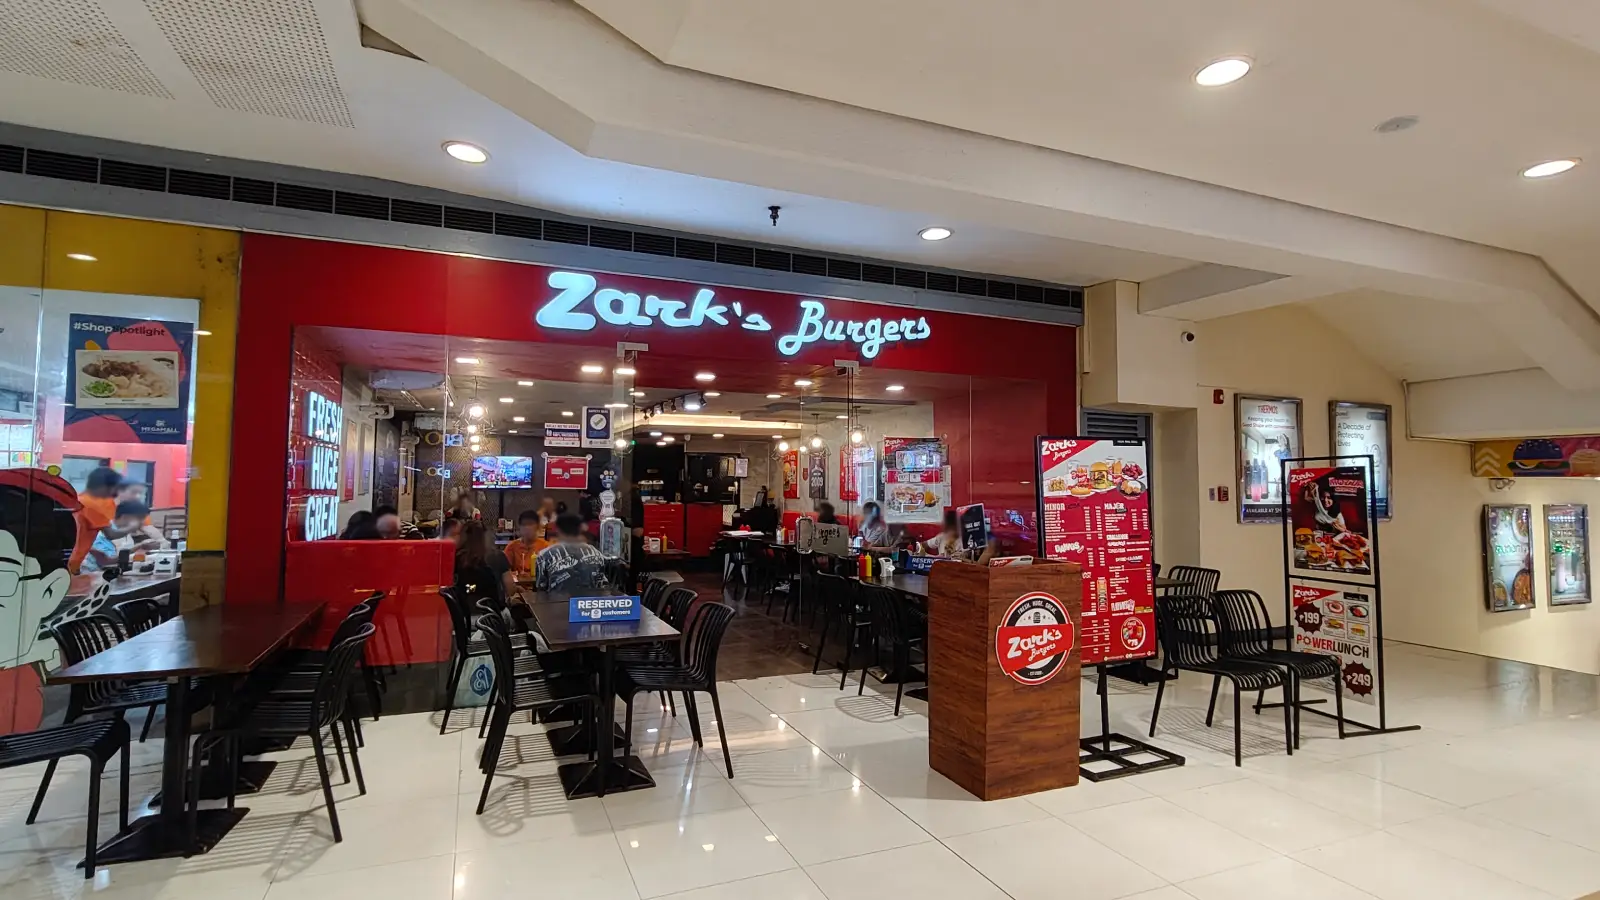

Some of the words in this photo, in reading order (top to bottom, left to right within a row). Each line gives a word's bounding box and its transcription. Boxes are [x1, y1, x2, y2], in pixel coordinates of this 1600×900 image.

[535, 271, 772, 332] Zark's
[777, 300, 932, 360] Burgers
[308, 391, 343, 445] FRESH
[1343, 422, 1364, 430] Decade
[1337, 431, 1365, 440] Protecting
[1338, 439, 1351, 447] Lives
[1042, 439, 1077, 456] Zark's
[311, 446, 340, 490] HUGE
[1045, 503, 1066, 511] MINOR
[305, 495, 340, 542] GREAT
[577, 599, 633, 609] RESERVED
[1007, 628, 1062, 659] Zark's
[1028, 642, 1057, 662] Burgers
